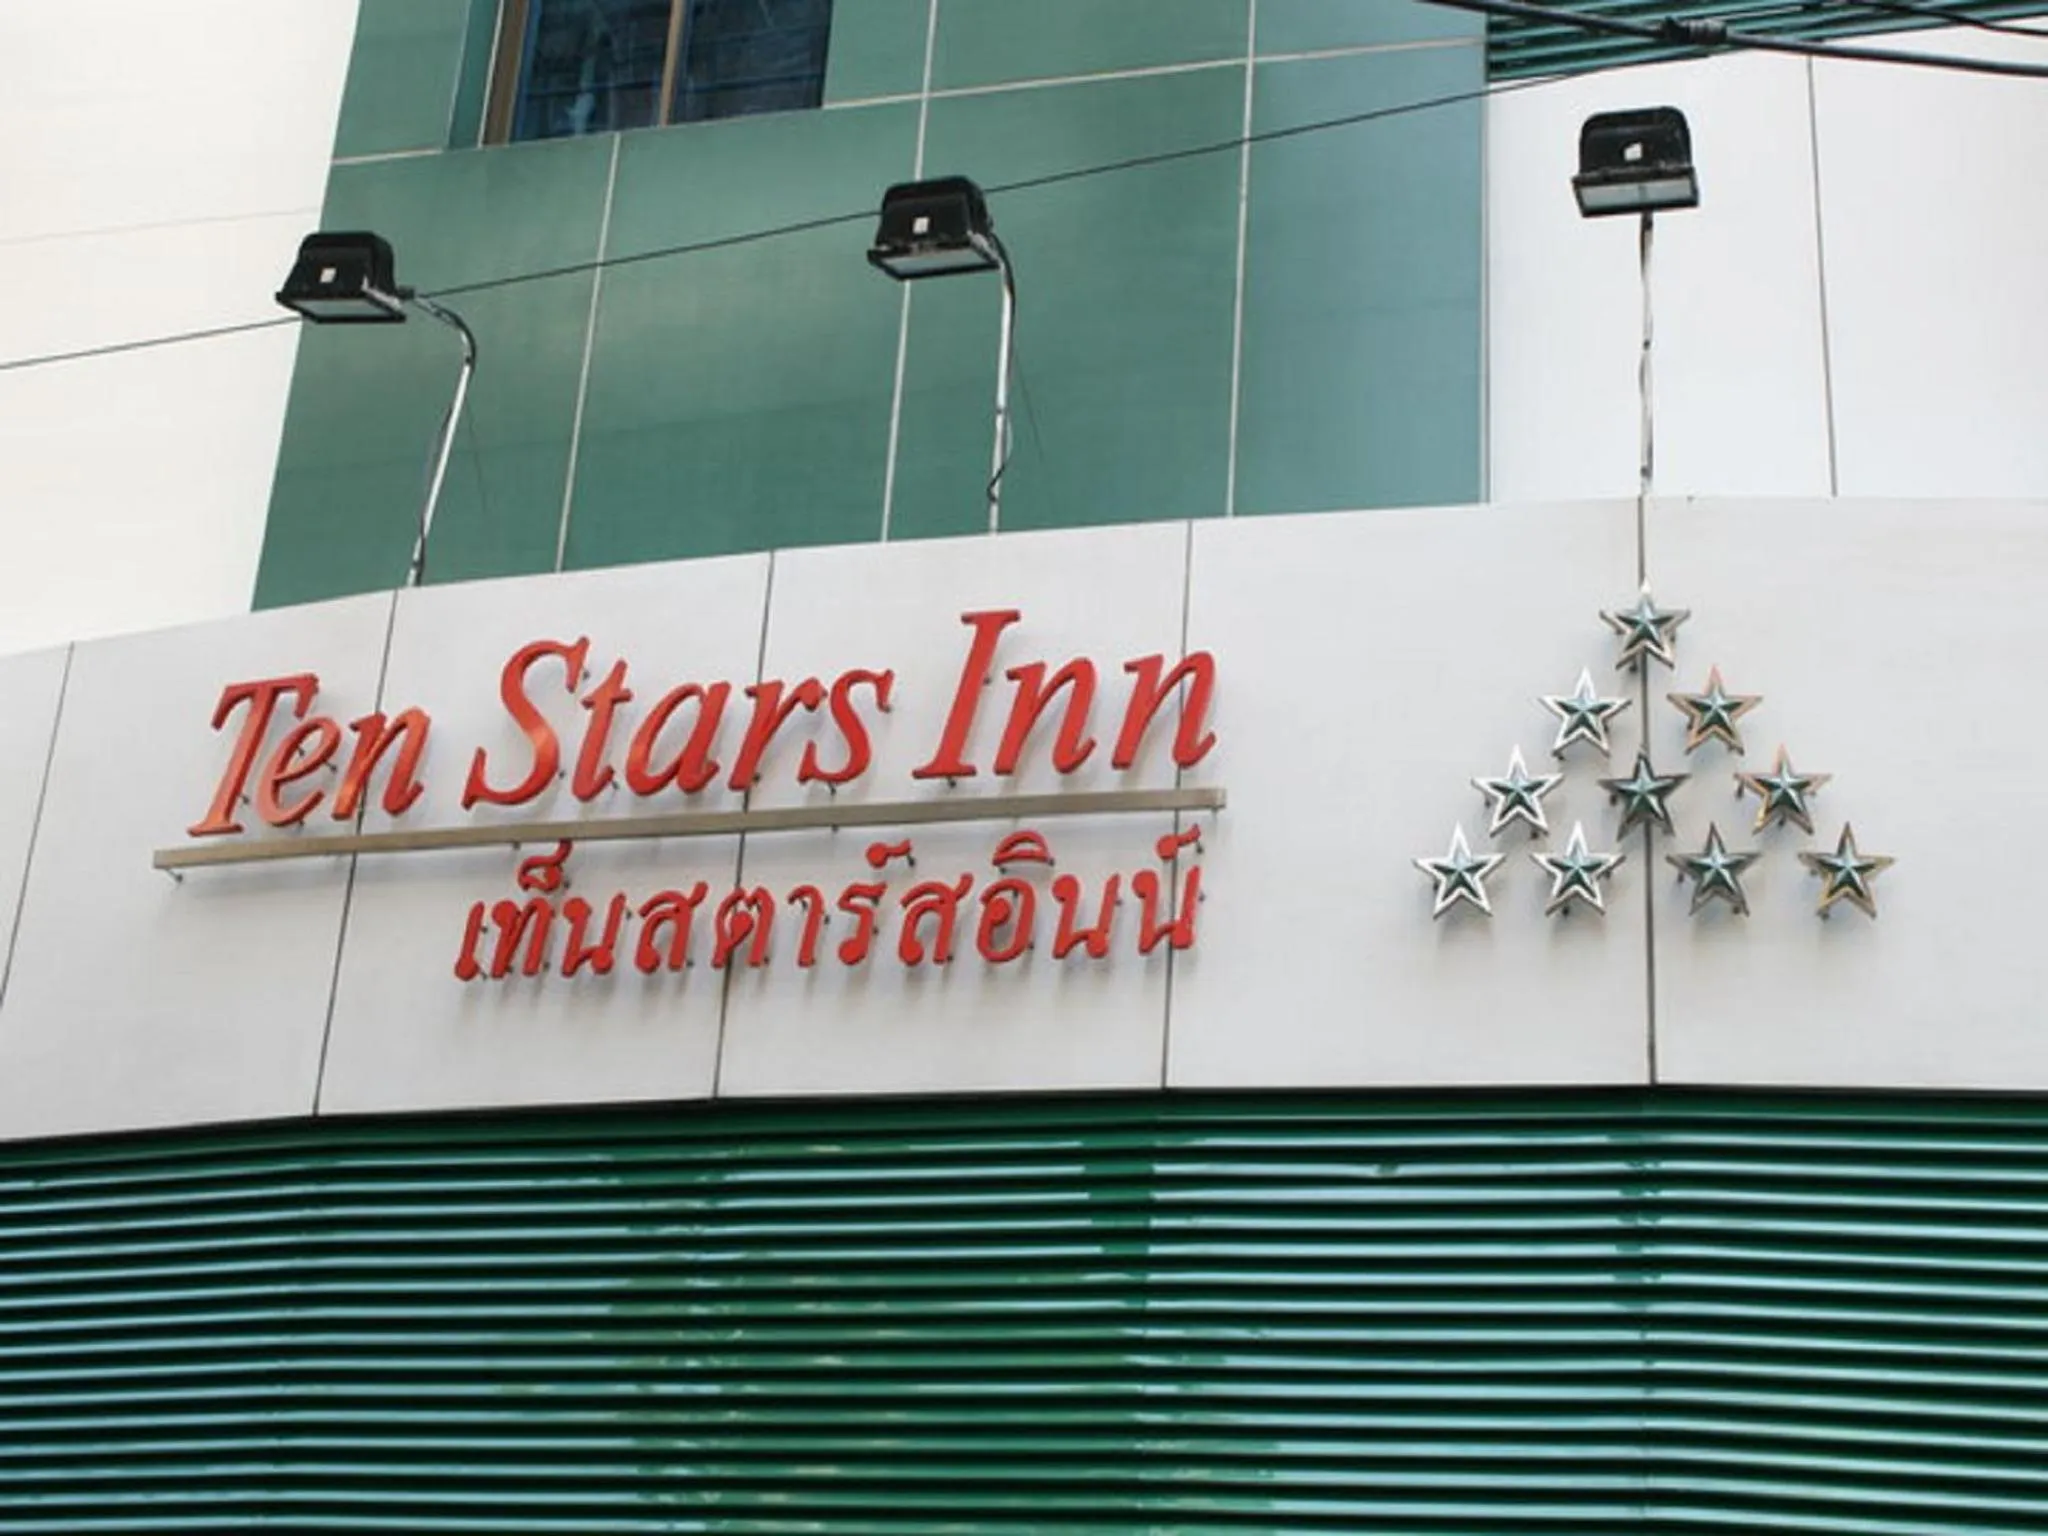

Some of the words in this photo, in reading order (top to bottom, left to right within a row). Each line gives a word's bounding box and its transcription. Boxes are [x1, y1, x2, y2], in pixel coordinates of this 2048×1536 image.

[188, 673, 430, 837] Ten
[463, 636, 895, 810] Stars
[912, 609, 1218, 781] Inn
[453, 825, 1202, 983] เท็นสตาร์สอินน์
